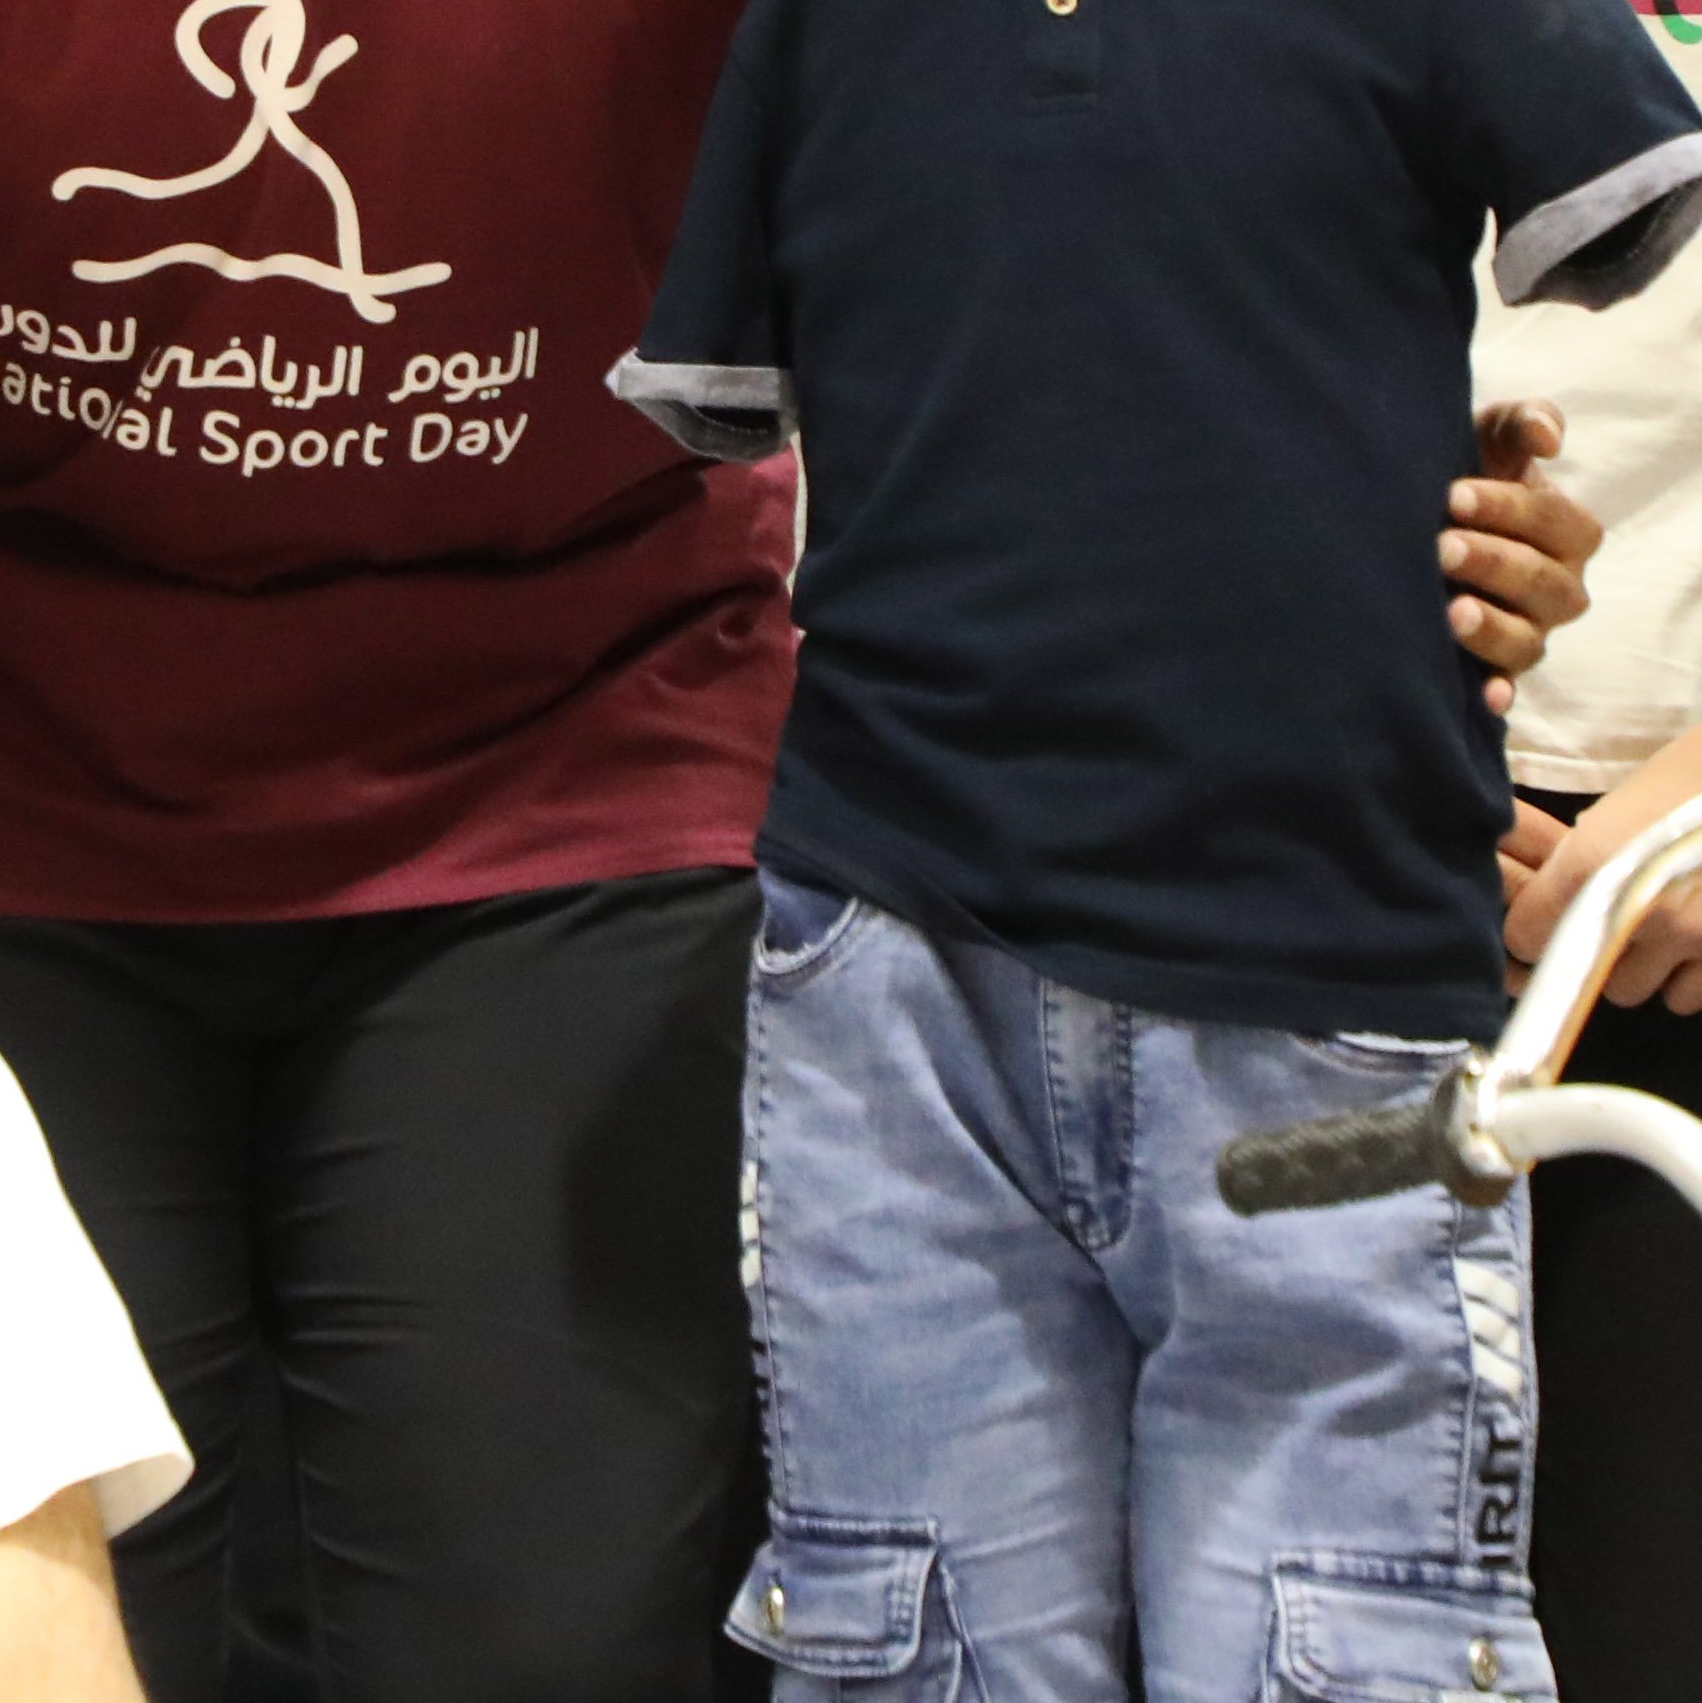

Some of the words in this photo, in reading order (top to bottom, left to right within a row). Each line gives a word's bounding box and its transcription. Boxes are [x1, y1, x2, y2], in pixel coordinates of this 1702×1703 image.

[135, 334, 364, 410] الرياضي
[387, 326, 539, 404] اليوم
[199, 409, 389, 477] Sport
[409, 411, 528, 464] Day
